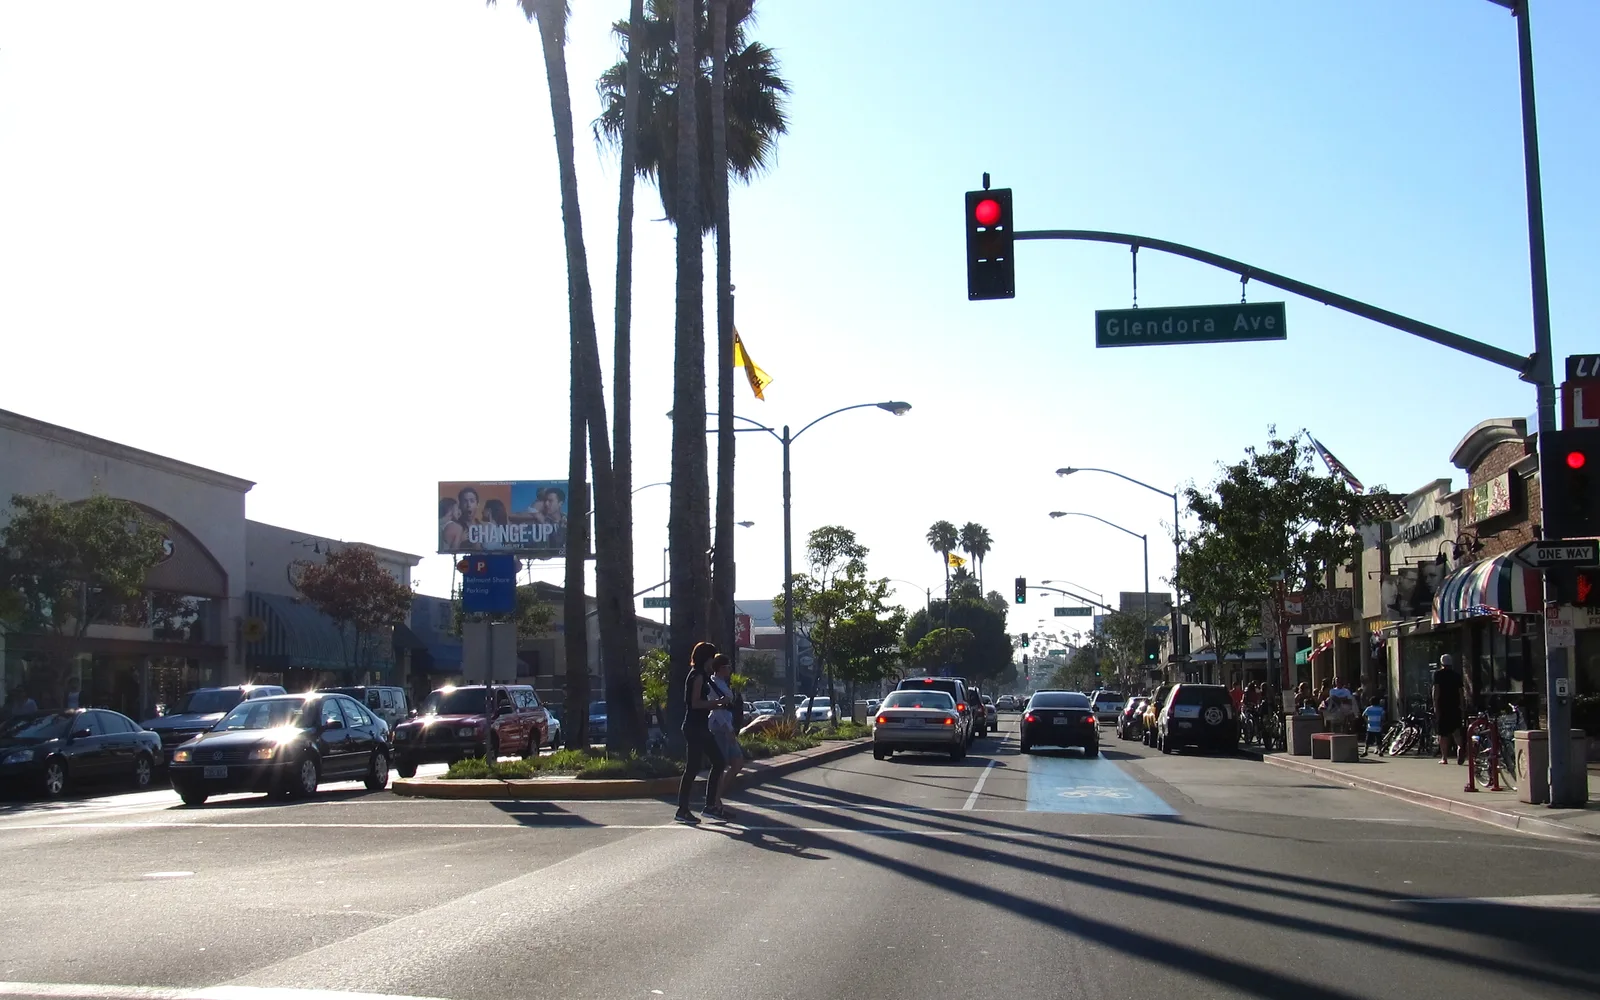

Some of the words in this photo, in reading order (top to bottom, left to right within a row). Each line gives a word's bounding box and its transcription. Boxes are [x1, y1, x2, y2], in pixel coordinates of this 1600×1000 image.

[1106, 317, 1215, 336] Glendora
[1233, 313, 1276, 331] Ave
[469, 523, 553, 543] CHANGE-UP
[1538, 548, 1562, 559] ONE
[1566, 547, 1590, 559] WAY
[477, 561, 485, 571] P
[466, 576, 490, 584] Belmont
[492, 576, 510, 584] Shore
[466, 587, 489, 595] Parking
